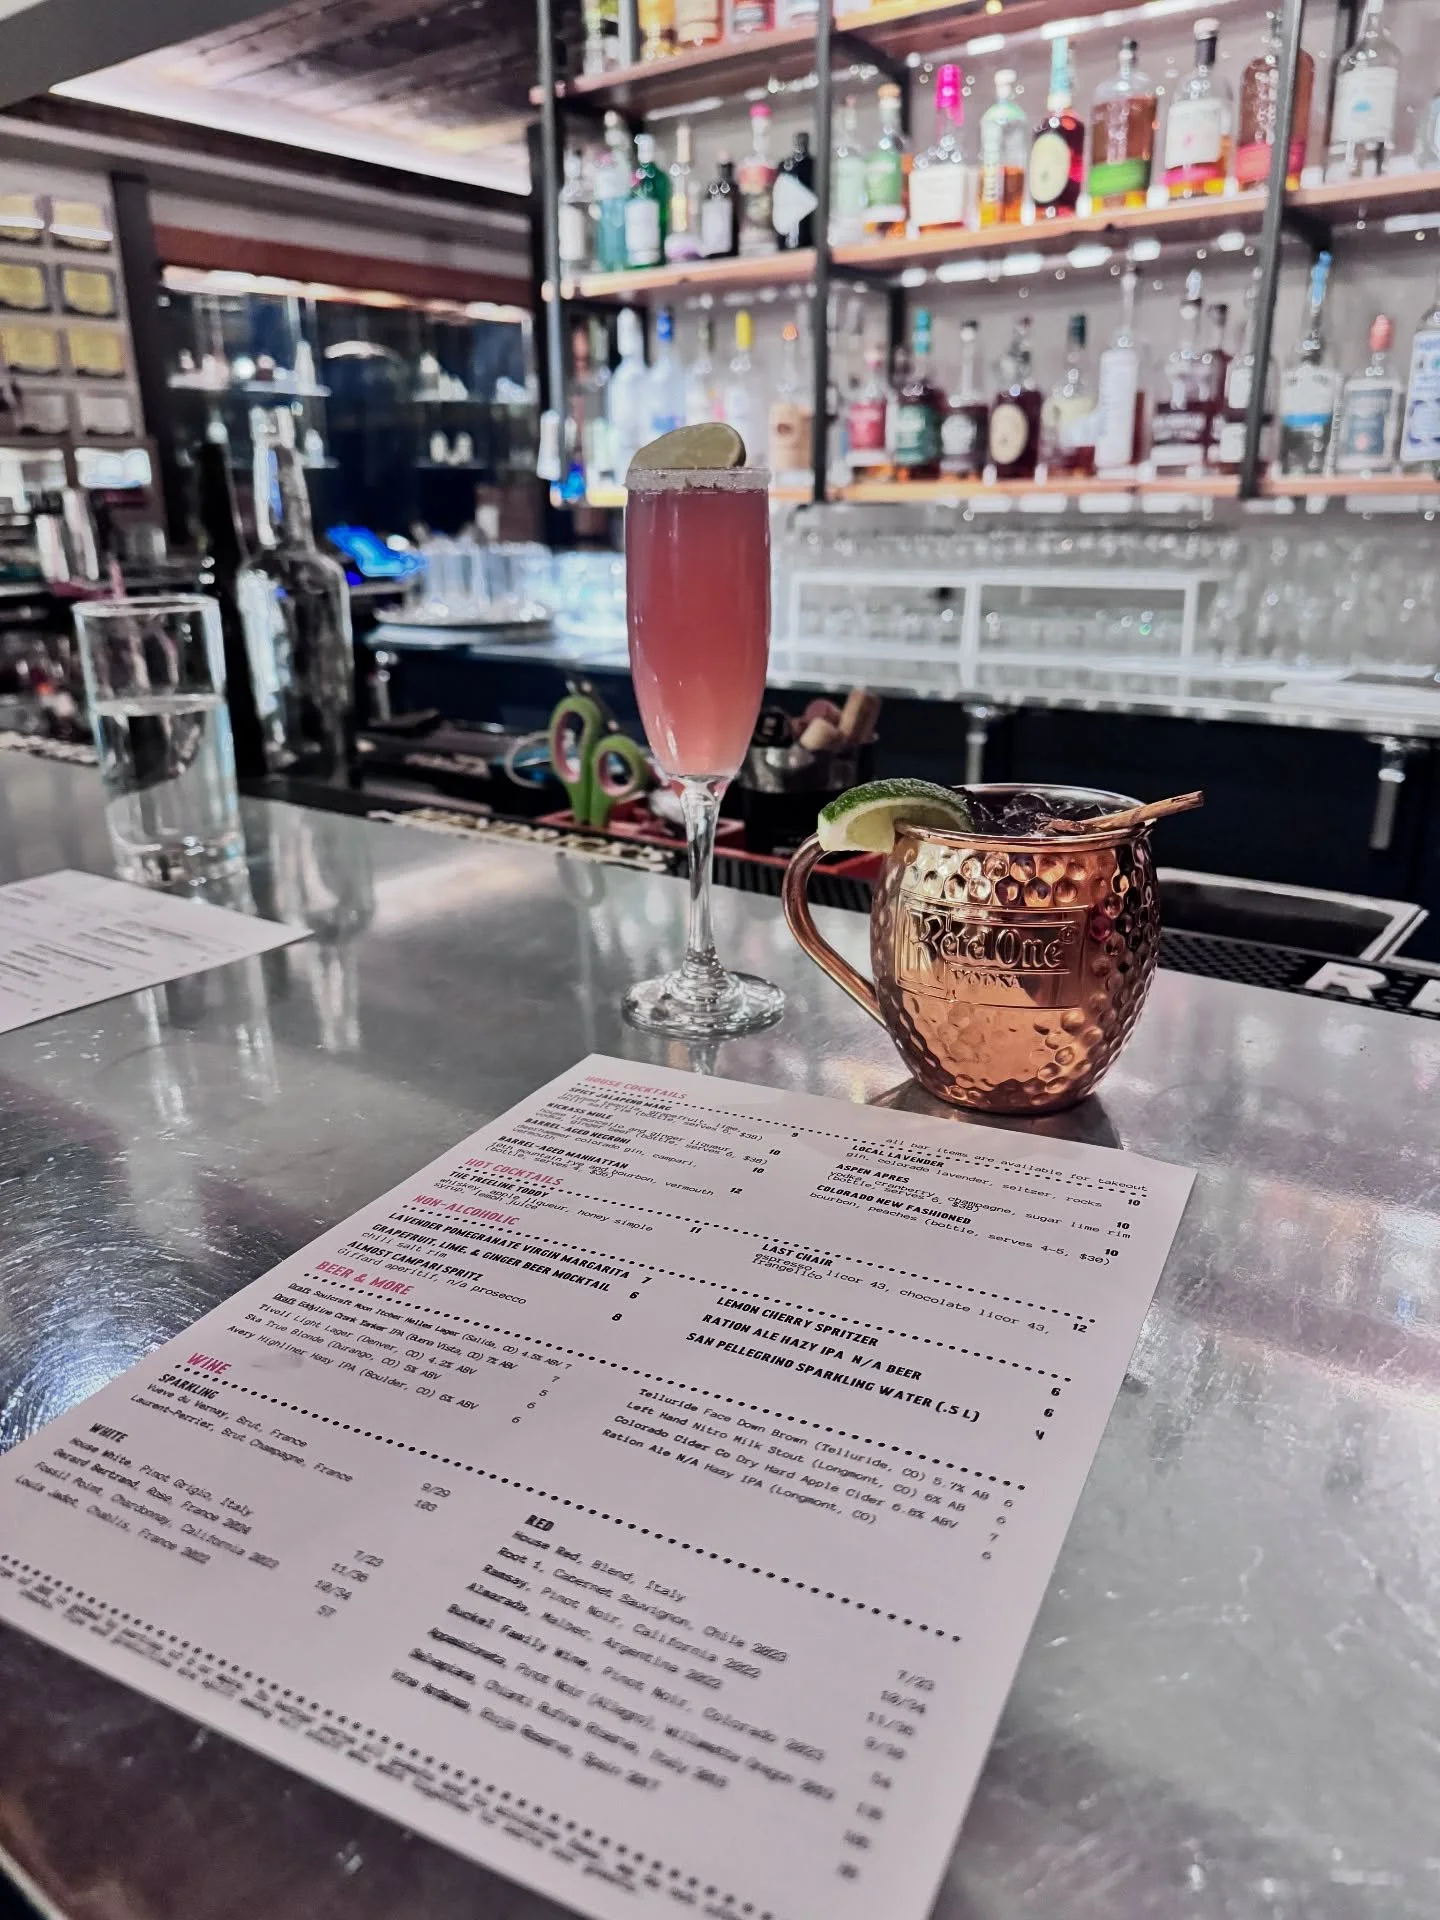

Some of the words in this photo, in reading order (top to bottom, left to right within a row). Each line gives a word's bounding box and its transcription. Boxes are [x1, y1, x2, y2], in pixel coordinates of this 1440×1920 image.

[995, 928, 1063, 968] One
[524, 1117, 591, 1136] BARREL-AGED
[589, 1131, 632, 1145] NEGRONI
[497, 1135, 566, 1155] BARREL-AGED
[564, 1151, 629, 1170] MANHATTAN
[769, 1148, 781, 1156] 10
[851, 1144, 884, 1156] LOCAL
[887, 1152, 945, 1168] LAVENDER
[464, 1158, 494, 1169] HOT
[492, 1164, 565, 1186] COCKTAILS
[835, 1163, 872, 1176] ASPEN
[872, 1171, 910, 1184] APRES
[885, 1138, 905, 1146] all
[910, 1142, 931, 1150] bar
[936, 1147, 968, 1158] items
[973, 1155, 995, 1163] are
[1000, 1160, 1063, 1177] available
[1069, 1173, 1090, 1181] for
[1098, 1178, 1148, 1192] takeout
[449, 1170, 470, 1180] THE
[469, 1175, 516, 1191] TREELINE
[515, 1185, 550, 1198] TODDY
[729, 1187, 743, 1195] 12
[412, 1194, 520, 1226] NON-ALCOHOLIC
[816, 1184, 875, 1202] COLORADO
[875, 1197, 905, 1209] NEW
[905, 1204, 972, 1225] FASHIONED
[1127, 1198, 1141, 1207] 10
[689, 1226, 703, 1234] 11
[1116, 1221, 1130, 1230] 10
[371, 1223, 438, 1247] GRAPEFRUIT,
[438, 1241, 469, 1255] LIME,
[469, 1248, 481, 1257] &
[481, 1251, 523, 1267] GINGER
[521, 1261, 552, 1275] BEER
[551, 1269, 611, 1292] MOCKTAIL
[388, 1212, 444, 1231] LAVENDER
[441, 1225, 522, 1250] POMEGRANATE
[521, 1244, 562, 1260] VIRGIN
[559, 1254, 630, 1279] MARGARITA
[761, 1243, 795, 1257] LAST
[795, 1252, 834, 1267] CHAIR
[1104, 1248, 1119, 1257] 10
[346, 1240, 394, 1258] ALMOST
[390, 1253, 444, 1272] CAMPARI
[440, 1265, 484, 1282] SPRITZ
[315, 1260, 355, 1279] BEER
[353, 1273, 368, 1284] &
[368, 1276, 415, 1296] MORE
[337, 1248, 384, 1266] Giffard
[384, 1263, 439, 1283] aperitif,
[445, 1279, 468, 1289] n/a
[469, 1285, 527, 1305] prosecco
[641, 1276, 653, 1284] 7
[629, 1291, 640, 1300] 6
[611, 1312, 623, 1322] 8
[716, 1296, 761, 1315] LEMON
[761, 1308, 814, 1329] CHERRY
[813, 1323, 879, 1347] SPRITZER
[1072, 1323, 1088, 1334] 12
[701, 1313, 752, 1333] RATION
[751, 1328, 780, 1342] ALE
[779, 1335, 819, 1352] HAZY
[819, 1346, 844, 1360] IPA
[851, 1354, 882, 1371] N/A
[885, 1364, 923, 1381] BEER
[186, 1352, 233, 1375] WINE
[158, 1373, 220, 1400] SPARKLING
[685, 1332, 716, 1346] SAN
[715, 1340, 795, 1369] PELLEGRINO
[794, 1362, 876, 1391] SPARKLING
[879, 1385, 933, 1408] WATER
[935, 1400, 960, 1415] (.5
[961, 1408, 980, 1423] L)
[1050, 1387, 1062, 1397] 6
[511, 1416, 521, 1424] 6
[1043, 1408, 1055, 1418] 6
[89, 1422, 129, 1444] WHITE
[524, 1514, 555, 1532] RED
